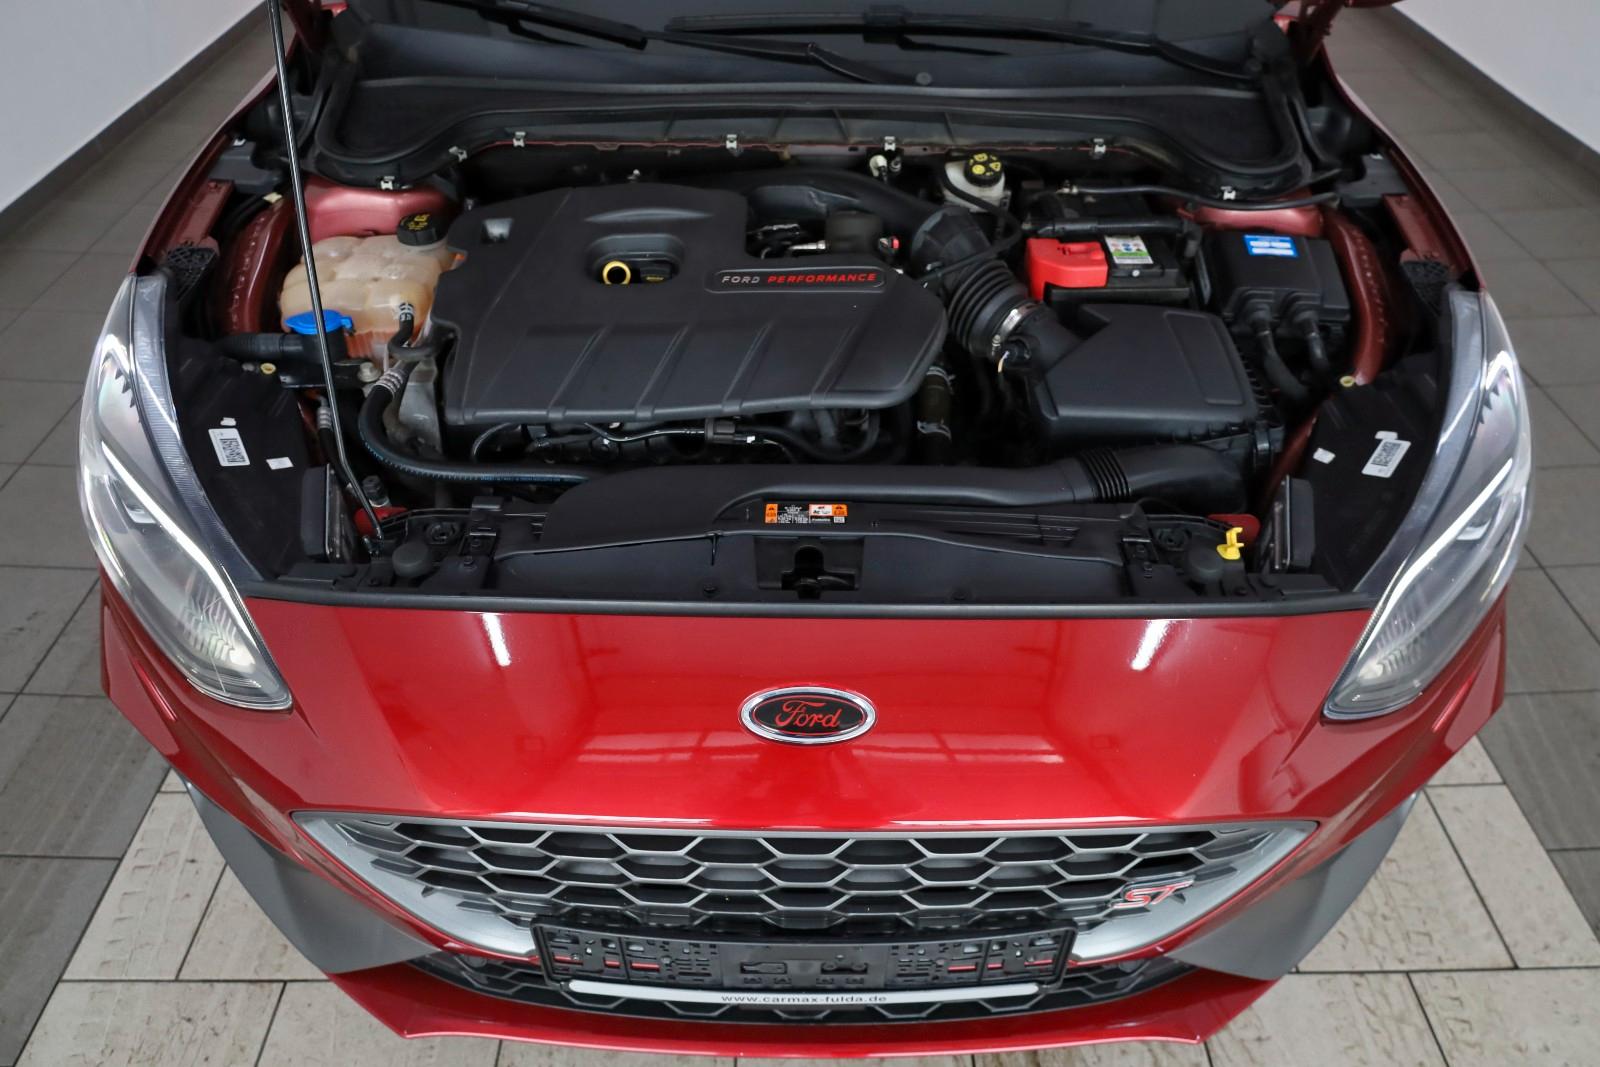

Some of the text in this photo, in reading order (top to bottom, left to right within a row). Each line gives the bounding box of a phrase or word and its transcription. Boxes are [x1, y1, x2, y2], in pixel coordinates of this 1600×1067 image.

[721, 273, 877, 284] FORD PERFORMANCE
[775, 700, 842, 728] Ford
[1112, 879, 1194, 910] ST
[721, 994, 888, 1004] www.carmax-fulda.de
